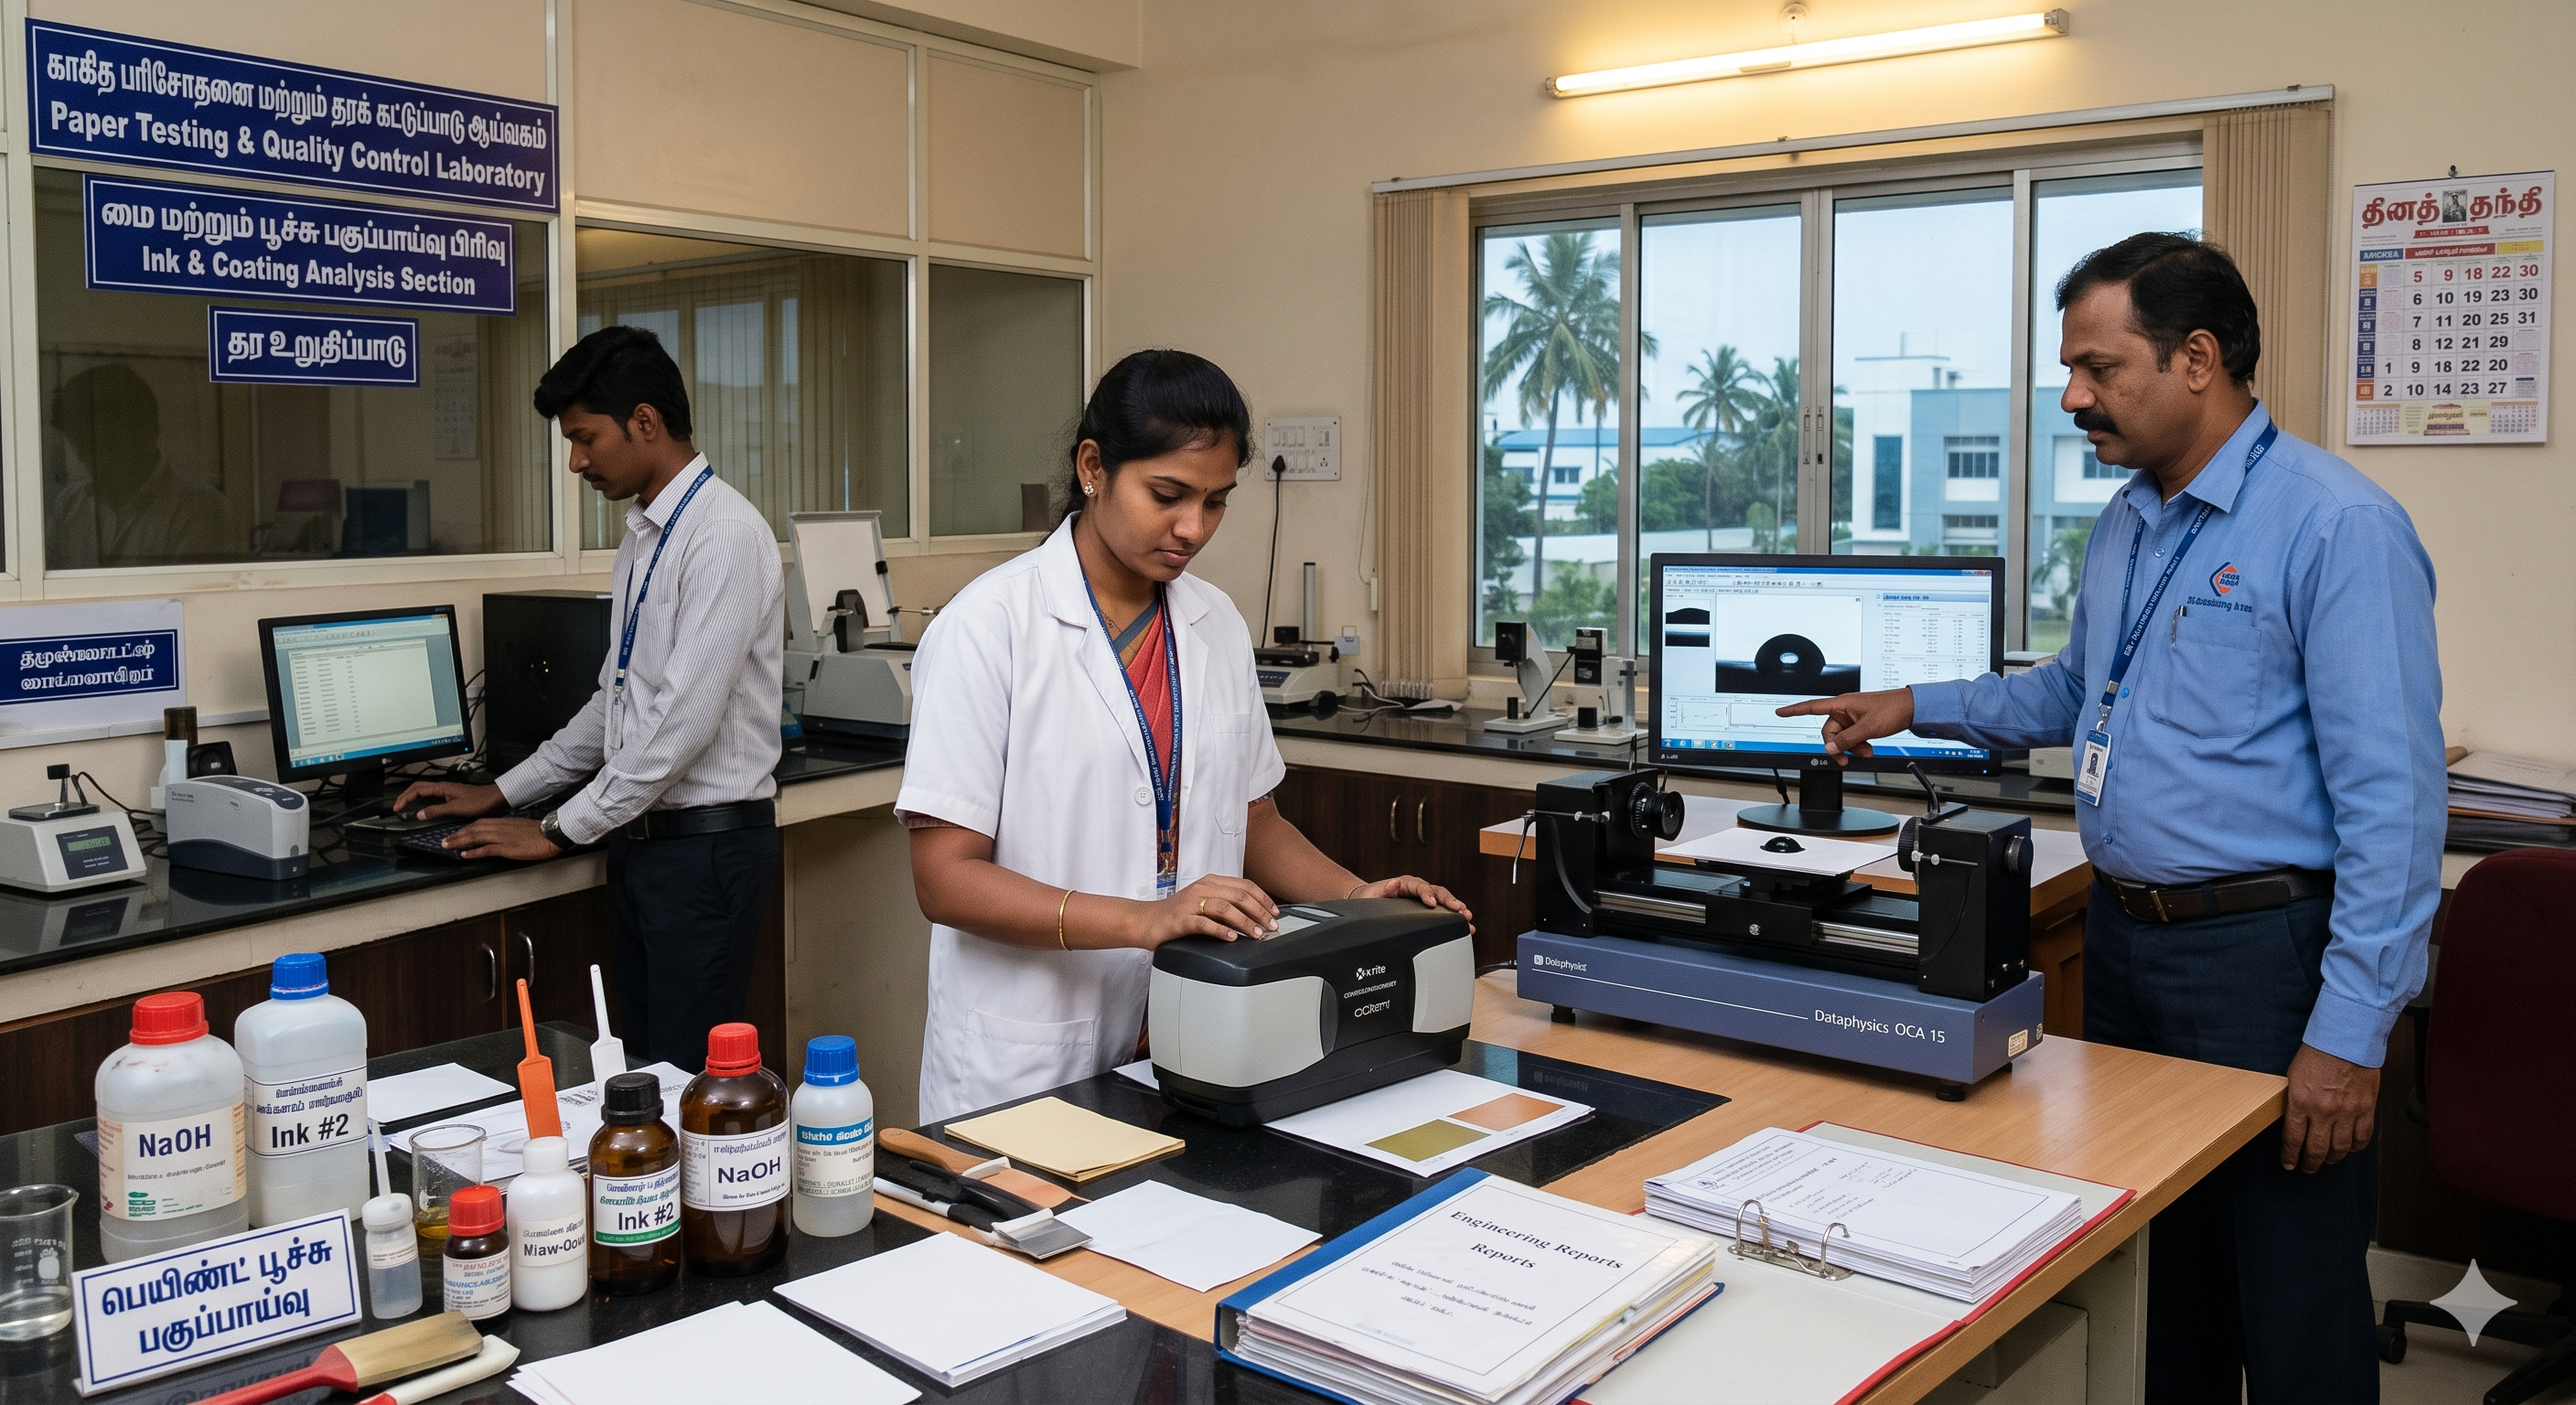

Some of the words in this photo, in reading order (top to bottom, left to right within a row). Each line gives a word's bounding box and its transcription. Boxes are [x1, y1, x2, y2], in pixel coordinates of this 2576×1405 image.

[47, 49, 115, 96] காகித
[121, 58, 254, 109] பரிசோதனை
[258, 80, 327, 125] மற்றும்
[331, 92, 372, 128] தரக்
[376, 102, 466, 145] கட்டுப்பாடு
[468, 112, 547, 149] ஆய்வகம்
[51, 100, 129, 142] Paper
[135, 112, 229, 159] Testing
[237, 125, 255, 156] &
[263, 130, 345, 173] Quality
[350, 142, 430, 177] Control
[436, 152, 545, 198] Laboratory
[2361, 192, 2441, 230] தினத்
[2470, 186, 2543, 222] தந்தி
[102, 202, 155, 229] மை
[161, 201, 254, 246] மற்றும்
[260, 211, 320, 251] பூச்சு
[324, 220, 446, 262] பகுப்பாய்வு
[450, 229, 506, 267] பிரிவு
[143, 245, 181, 273] Ink
[188, 249, 206, 275] &
[212, 251, 299, 289] Coating
[305, 259, 395, 294] Analysis
[401, 266, 476, 295] Section
[2413, 271, 2423, 284] 5
[2443, 269, 2453, 282] 9
[2464, 267, 2483, 281] 18
[2491, 265, 2511, 279] 22
[2519, 264, 2539, 277] 30
[2412, 293, 2422, 306] 6
[2436, 292, 2454, 305] 10
[2463, 290, 2483, 303] 19
[2490, 289, 2510, 302] 23
[2518, 287, 2538, 301] 30
[2412, 316, 2422, 328] 7
[2435, 315, 2453, 327] 11
[2462, 313, 2482, 327] 20
[2490, 313, 2509, 326] 25
[2517, 311, 2536, 324] 31
[228, 331, 264, 364] தர
[269, 329, 406, 369] உறுதிப்பாடு
[2411, 338, 2421, 351] 8
[2435, 338, 2453, 350] 12
[2462, 337, 2479, 349] 21
[2489, 336, 2509, 349] 29
[2385, 362, 2391, 374] 1
[2411, 361, 2420, 374] 9
[2434, 360, 2453, 373] 18
[2461, 359, 2480, 372] 22
[2488, 359, 2508, 371] 20
[2383, 384, 2393, 397] 2
[2407, 383, 2424, 396] 10
[2433, 383, 2452, 395] 14
[2460, 382, 2480, 395] 23
[2488, 382, 2507, 394] 27
[1814, 1009, 1889, 1034] Dataphysics
[1894, 1023, 1926, 1040] OCA
[1930, 1029, 1946, 1044] 15
[139, 1123, 211, 1158] NaOH
[272, 1122, 310, 1149] Ink
[317, 1113, 349, 1141] #2
[717, 1155, 781, 1184] NaOH
[618, 1210, 650, 1230] Ink
[654, 1201, 674, 1226] #2
[1450, 1210, 1551, 1249] Engineering
[1553, 1243, 1624, 1270] Reports
[1469, 1243, 1537, 1269] Reports
[102, 1257, 251, 1316] பெயிண்ட்
[258, 1236, 333, 1285] பூச்சு
[138, 1286, 311, 1355] பகுப்பாய்வு
